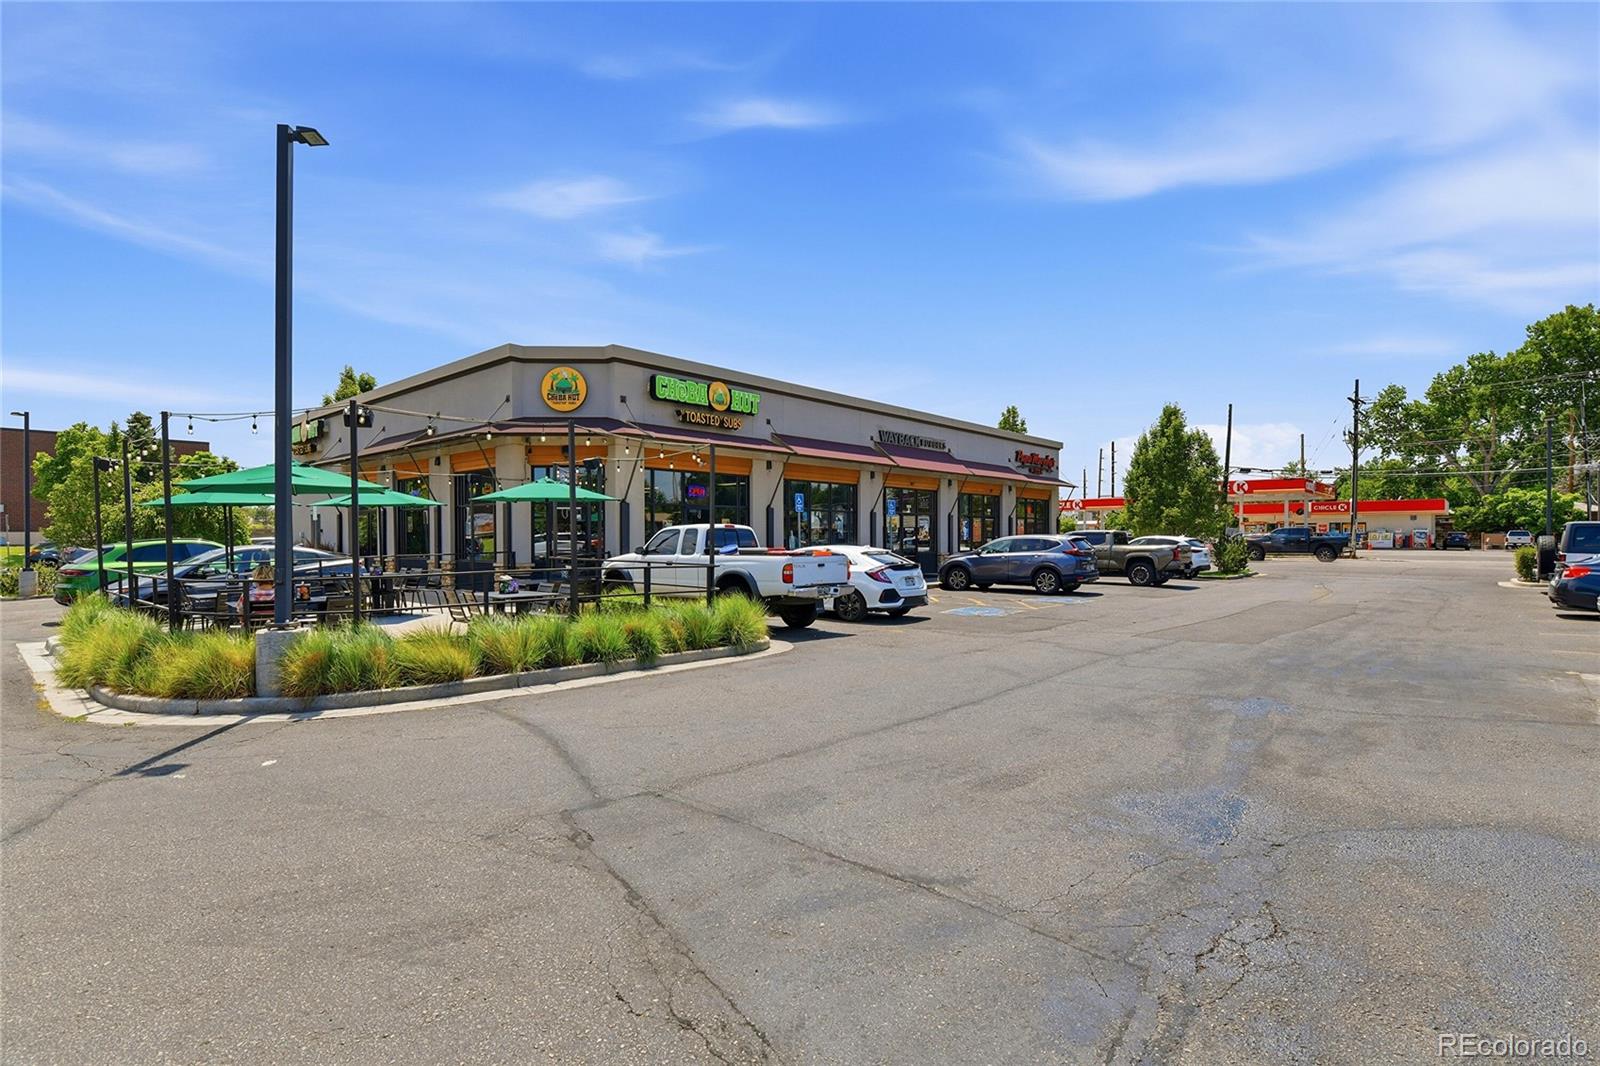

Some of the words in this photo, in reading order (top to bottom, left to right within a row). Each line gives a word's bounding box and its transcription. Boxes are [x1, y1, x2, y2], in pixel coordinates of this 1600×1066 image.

[730, 389, 760, 414] HUT
[723, 416, 742, 429] SUBS
[878, 430, 920, 447] WAYBACK
